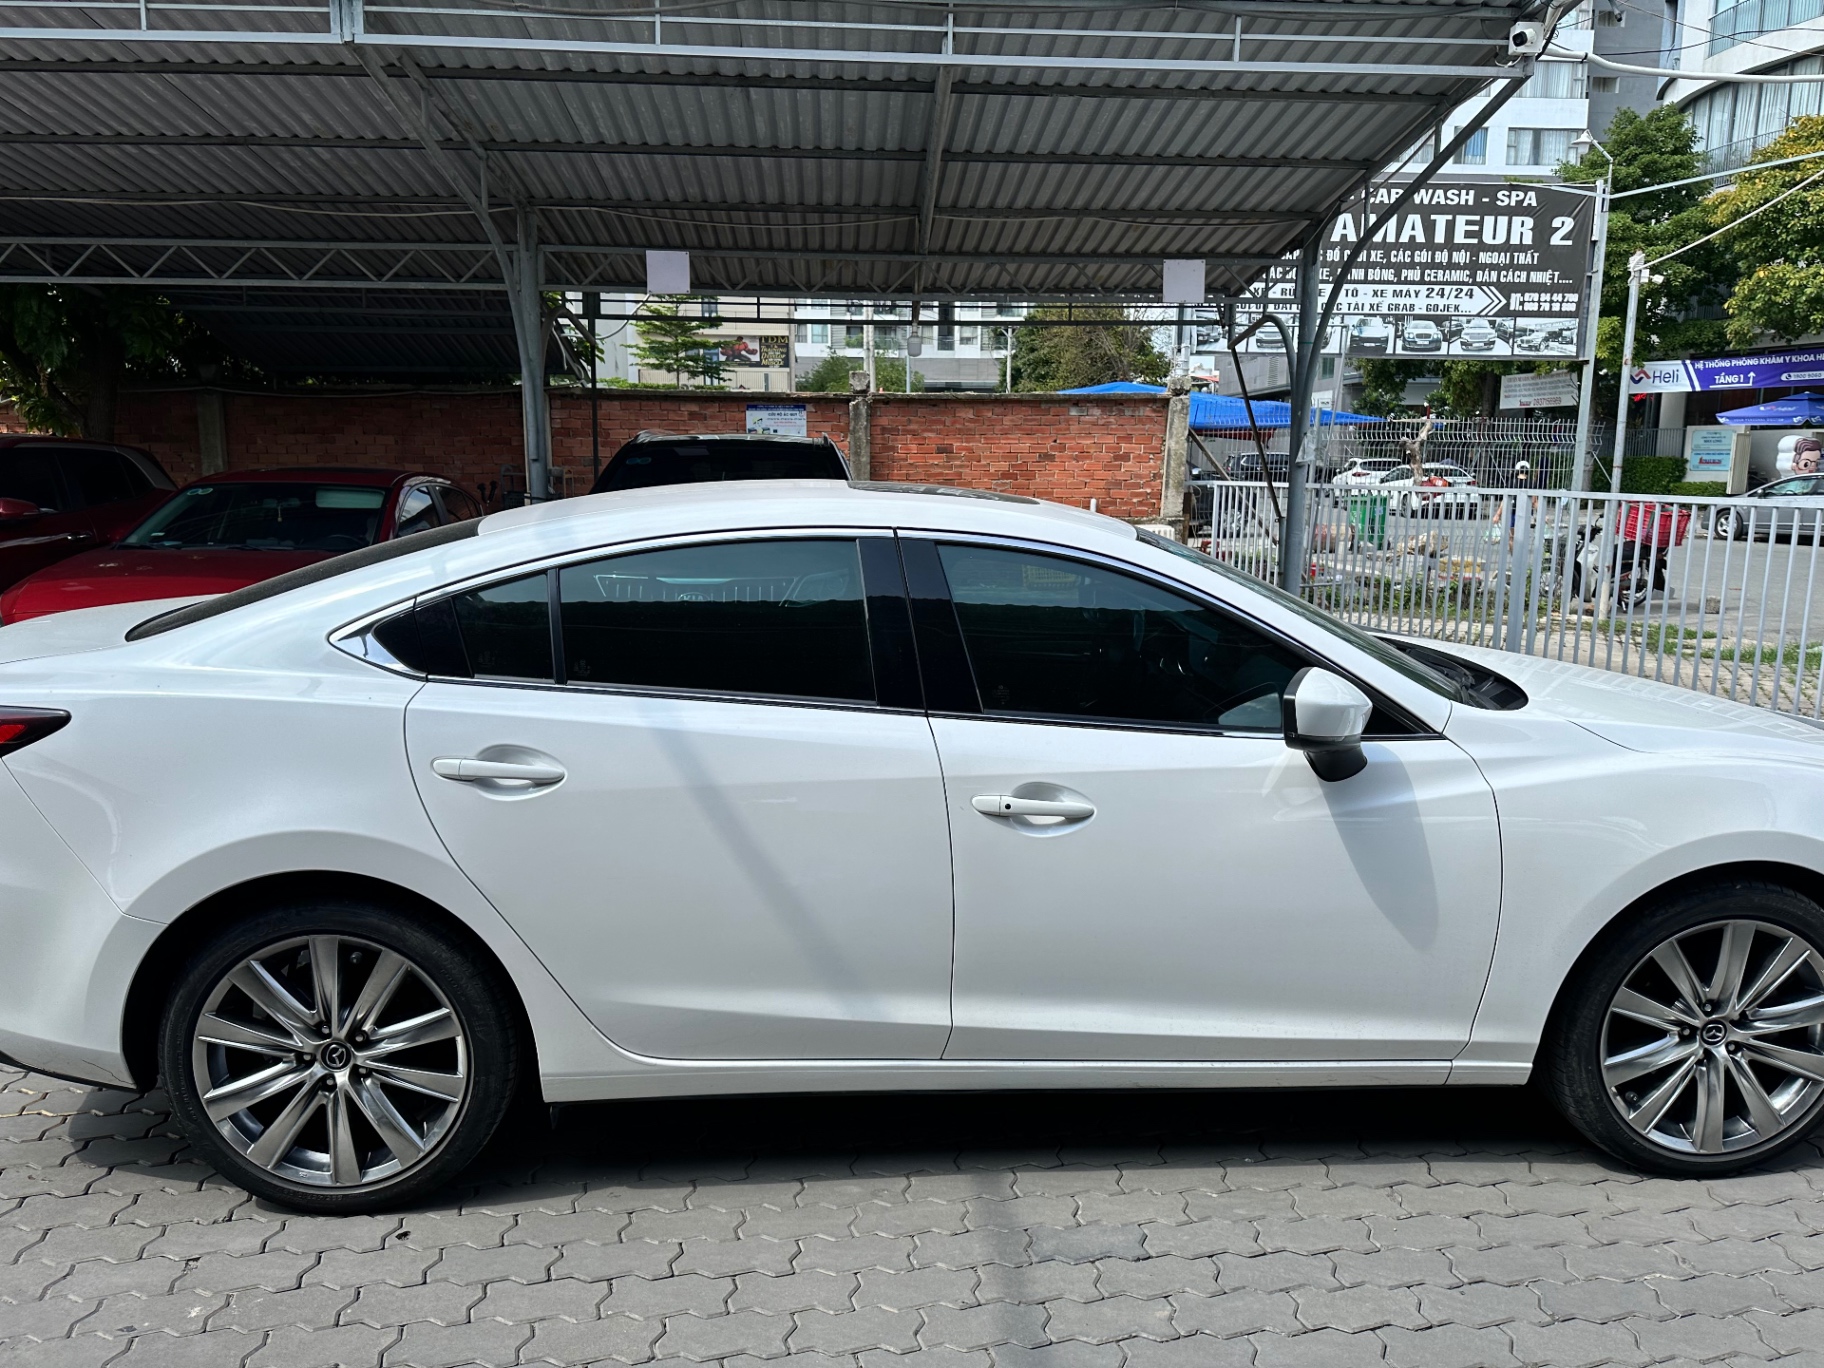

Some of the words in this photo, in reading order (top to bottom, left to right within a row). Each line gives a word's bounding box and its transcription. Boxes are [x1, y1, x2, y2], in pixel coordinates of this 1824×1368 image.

[1413, 188, 1475, 206] WASH
[1495, 190, 1538, 207] SPA
[1330, 213, 1534, 245] AMATEUR
[1549, 216, 1575, 246] 2
[1369, 250, 1387, 264] XE,
[1390, 248, 1411, 263] CÁC
[1414, 248, 1432, 263] GÓI
[1434, 249, 1448, 266] ĐỘ
[1451, 249, 1470, 266] NỘI
[1478, 251, 1510, 267] NGOẠI
[1513, 249, 1540, 265] THẤT
[1367, 267, 1398, 282] BÓNG,
[1401, 266, 1421, 281] PHỦ
[1424, 268, 1473, 283] CERAMIC,
[1475, 268, 1498, 282] DÁN
[1499, 268, 1527, 283] CÁCH
[1371, 289, 1388, 298] XE
[1392, 287, 1421, 299] MÁY
[1425, 287, 1475, 300] 24/24
[1346, 301, 1365, 312] TÀI
[1368, 300, 1385, 312] XẾ
[1387, 303, 1415, 312] GRAB
[1425, 303, 1471, 313] GOJEK...
[1704, 358, 1731, 369] THỐNG
[1785, 355, 1791, 363] Y
[1791, 354, 1815, 363] KHOA
[1652, 369, 1680, 384] Heli
[1739, 374, 1744, 383] 1
